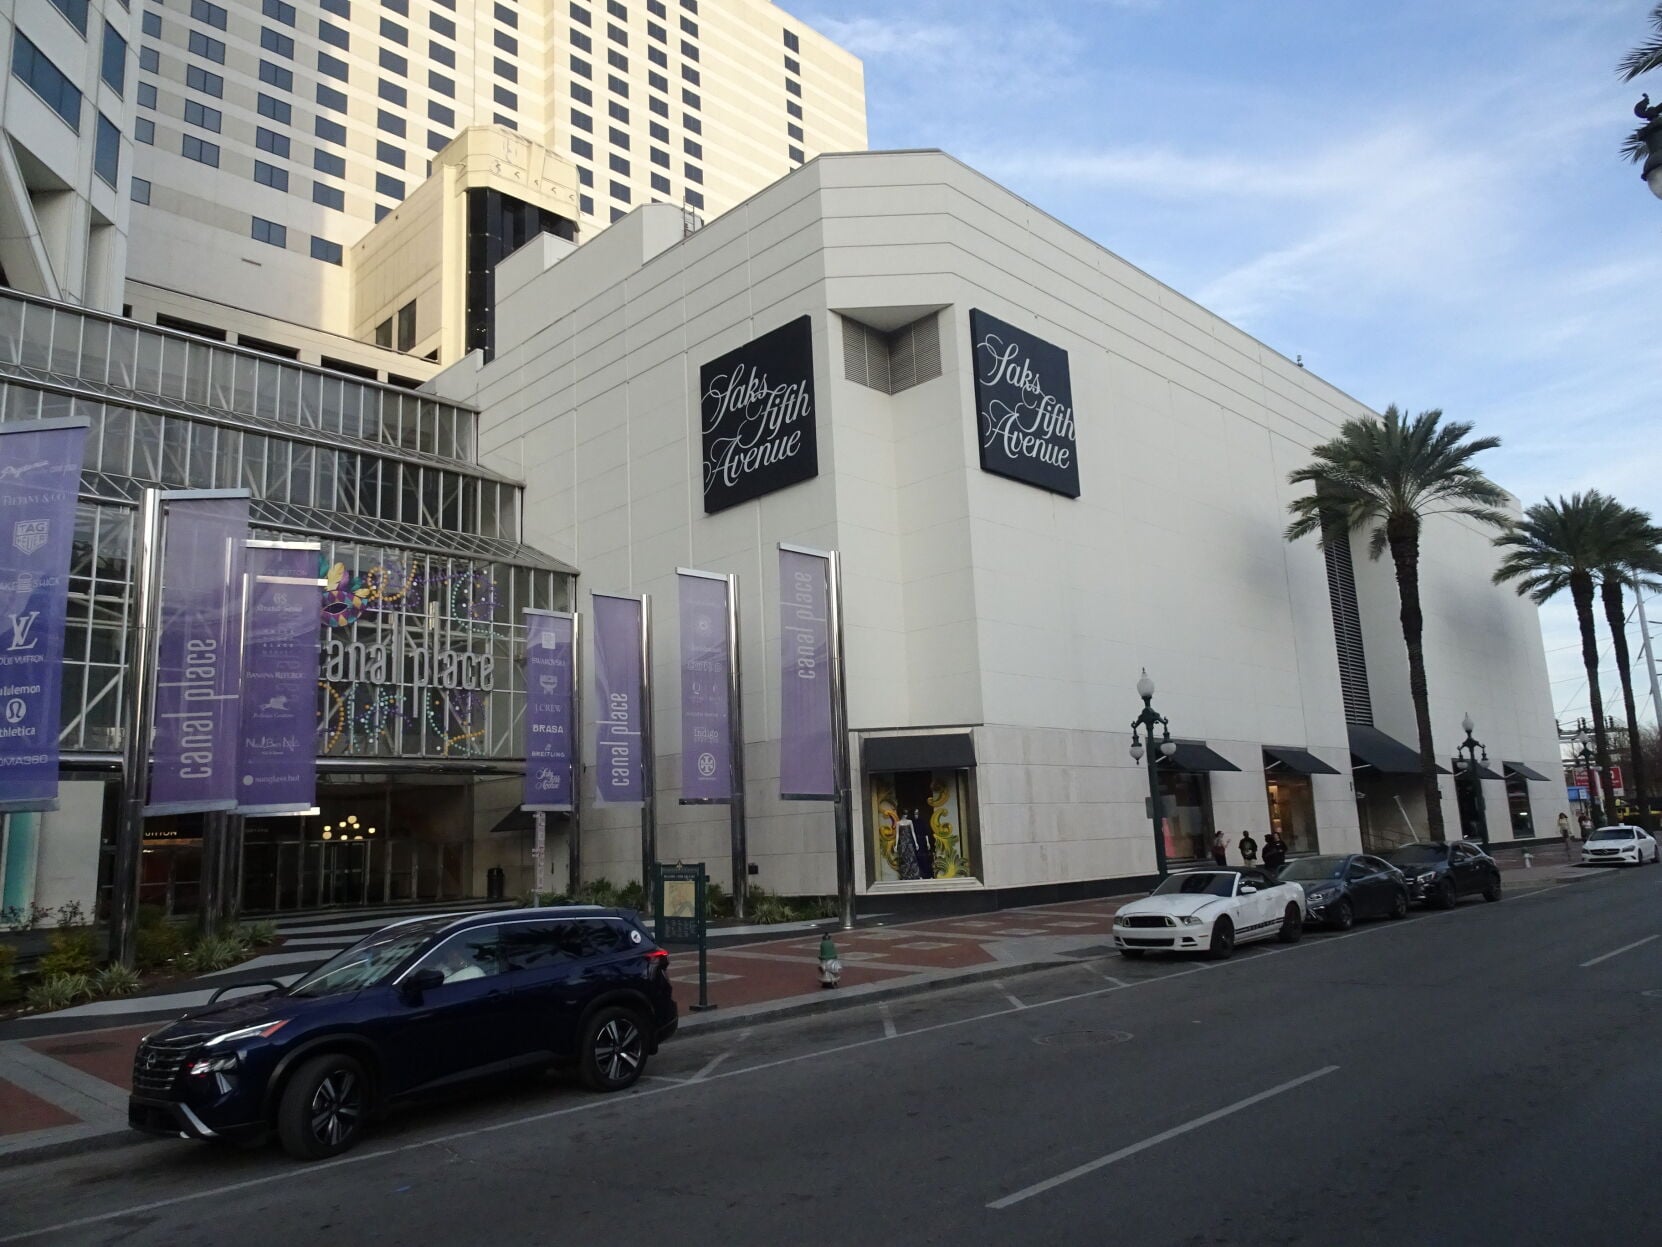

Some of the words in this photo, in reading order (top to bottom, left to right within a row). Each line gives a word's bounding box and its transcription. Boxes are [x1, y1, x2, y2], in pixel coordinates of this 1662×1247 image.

[977, 334, 1041, 394] Saks
[702, 363, 767, 435] Saks
[982, 400, 1070, 469] Avenue
[703, 434, 801, 496] Avenue
[18, 522, 46, 534] TAG
[779, 571, 827, 622] place
[158, 639, 240, 701] place
[318, 611, 398, 684] anal
[410, 601, 494, 718] place
[784, 625, 816, 679] canal
[532, 723, 564, 734] BRASA
[595, 692, 641, 735] place
[161, 711, 213, 779] canal
[599, 741, 630, 786] canal
